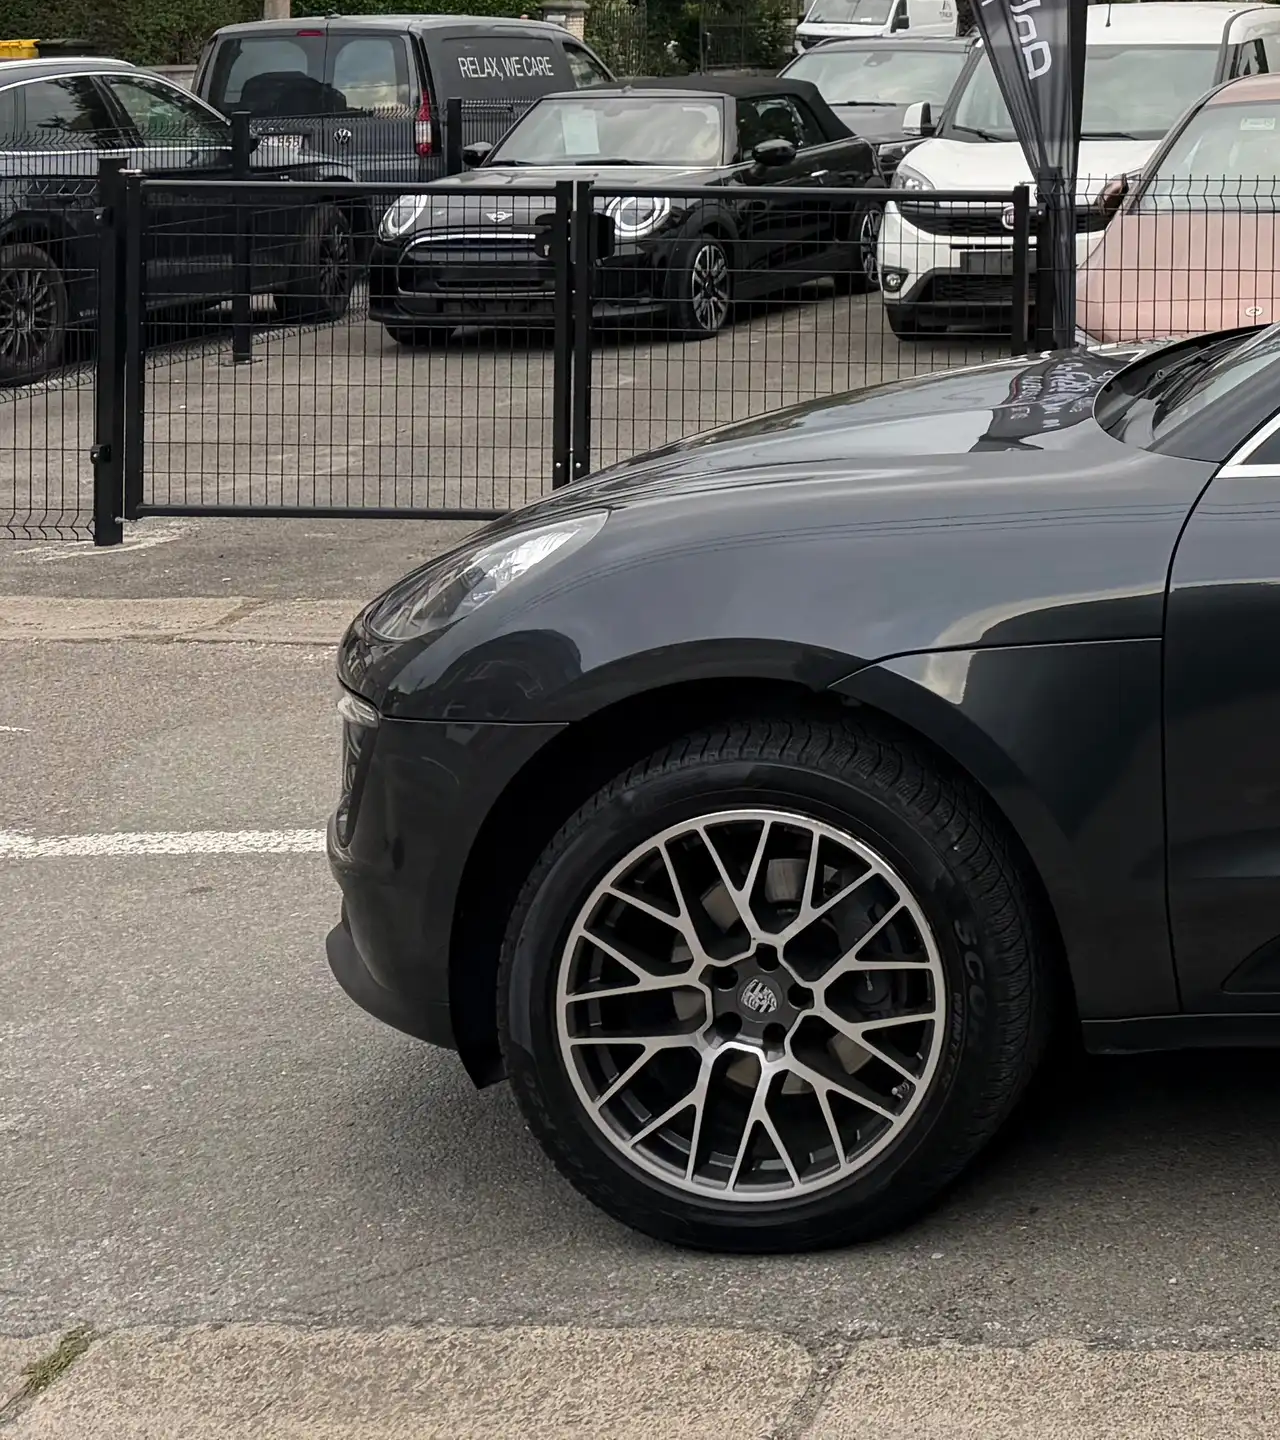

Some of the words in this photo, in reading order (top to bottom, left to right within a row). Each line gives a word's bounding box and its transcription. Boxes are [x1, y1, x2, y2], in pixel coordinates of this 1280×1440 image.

[457, 56, 504, 81] RELAX,
[500, 56, 524, 77] WE
[522, 55, 555, 77] CARE
